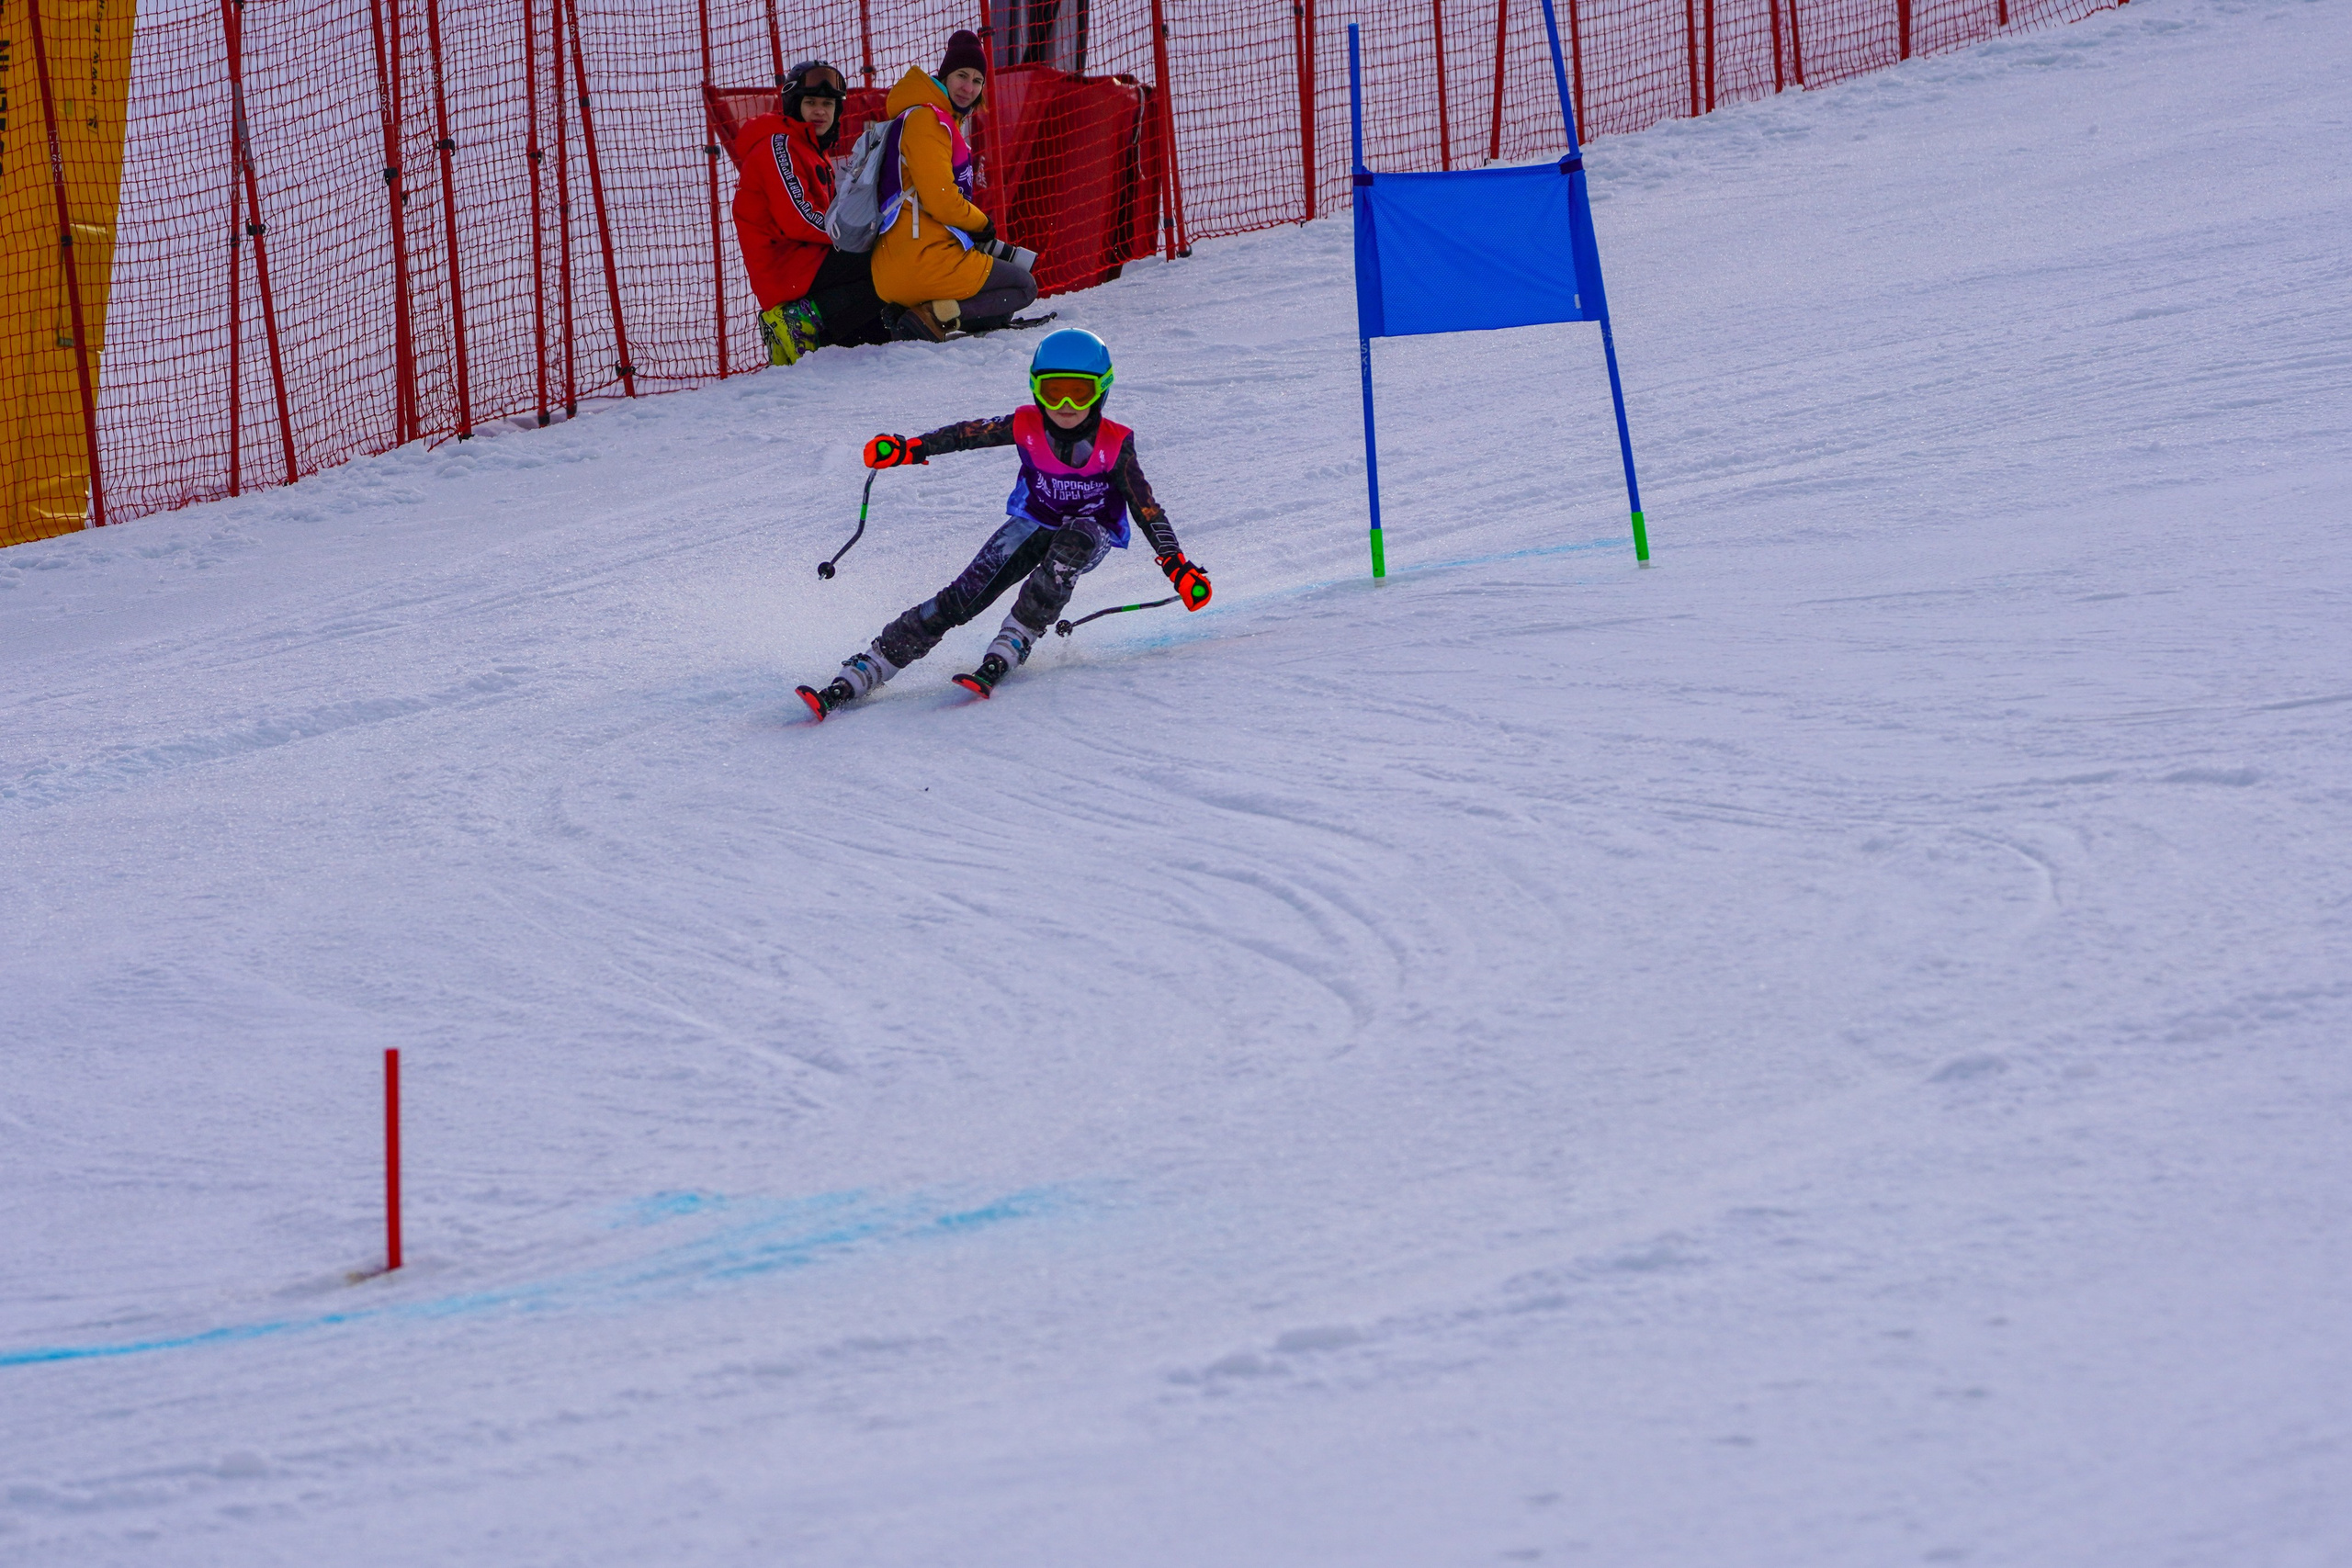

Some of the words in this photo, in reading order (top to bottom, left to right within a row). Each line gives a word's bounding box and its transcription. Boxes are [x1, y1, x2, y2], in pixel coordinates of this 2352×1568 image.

[568, 6, 577, 51] LISKI
[379, 75, 388, 121] LISKI
[1053, 488, 1081, 501] ГОРЫ
